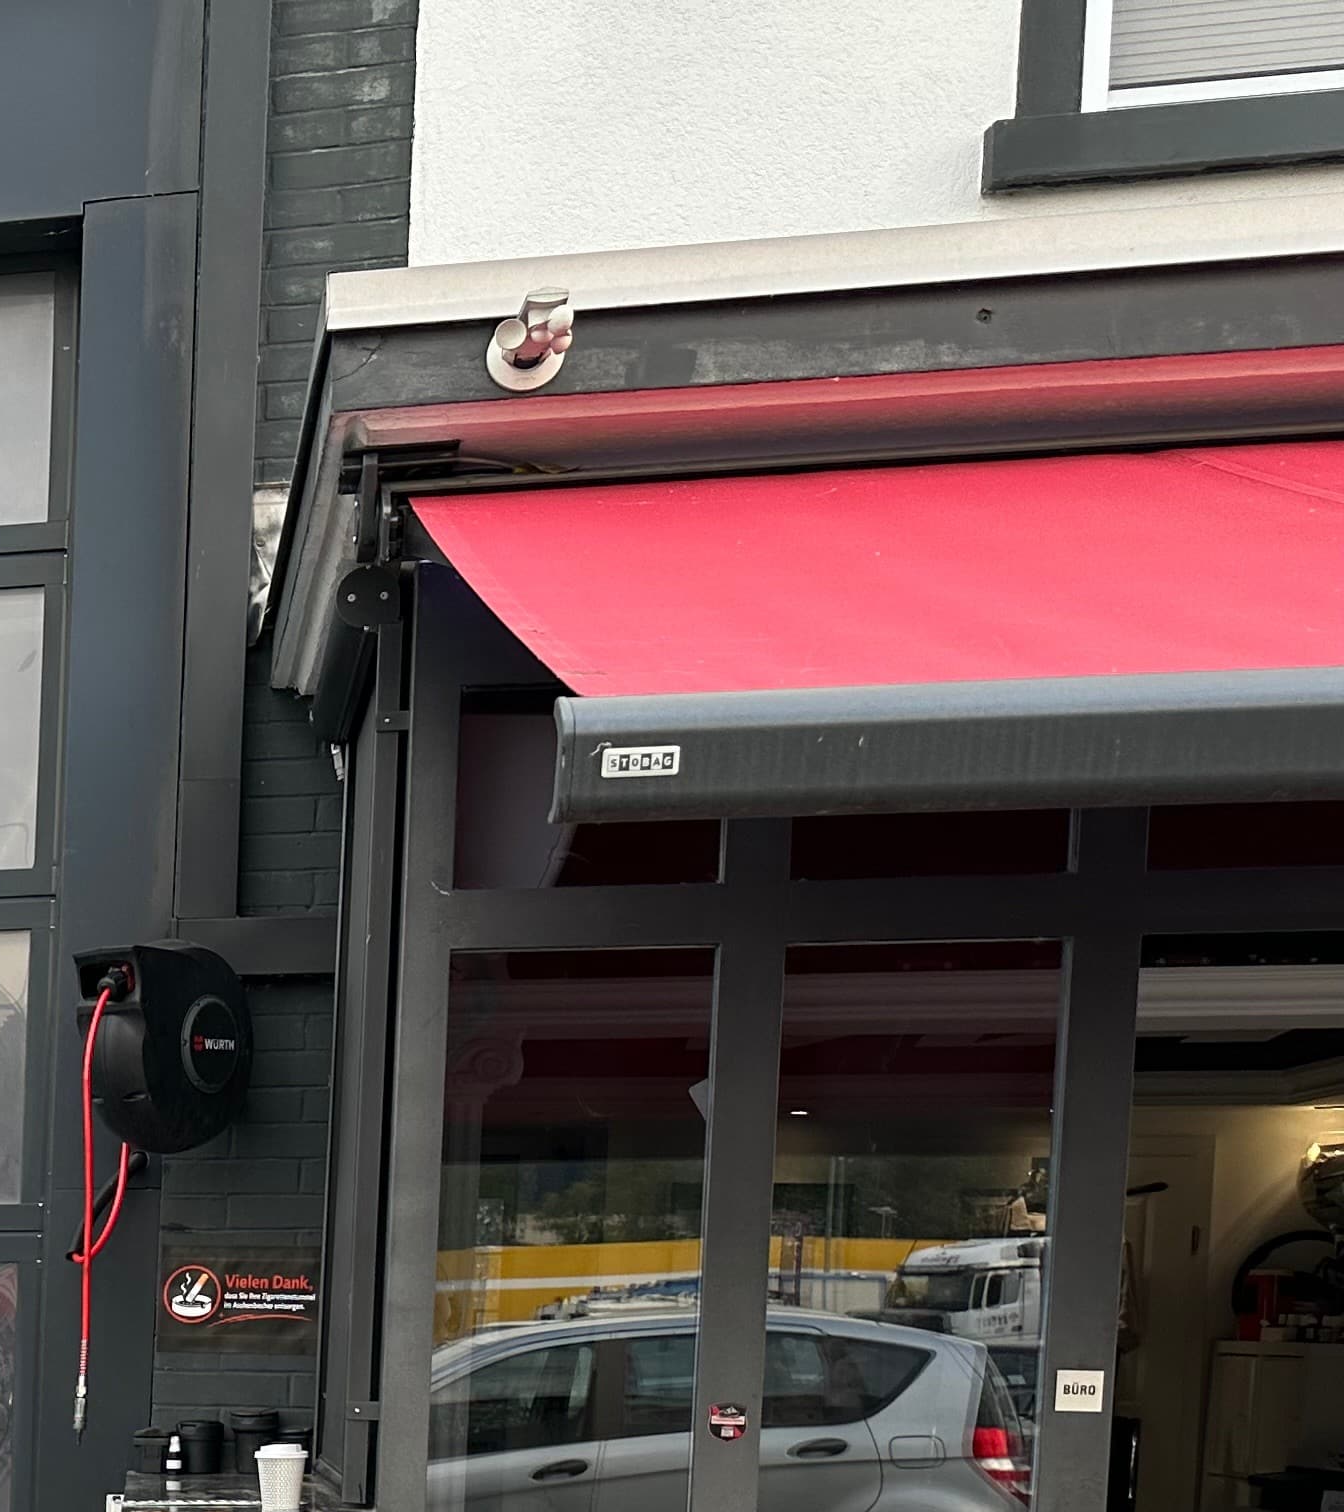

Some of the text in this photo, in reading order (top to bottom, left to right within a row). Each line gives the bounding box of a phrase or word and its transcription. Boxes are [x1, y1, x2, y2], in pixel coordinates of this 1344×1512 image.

[609, 753, 674, 769] STOBAG
[225, 1274, 313, 1291] Vielen Dank,
[1062, 1381, 1096, 1396] BÜRO
